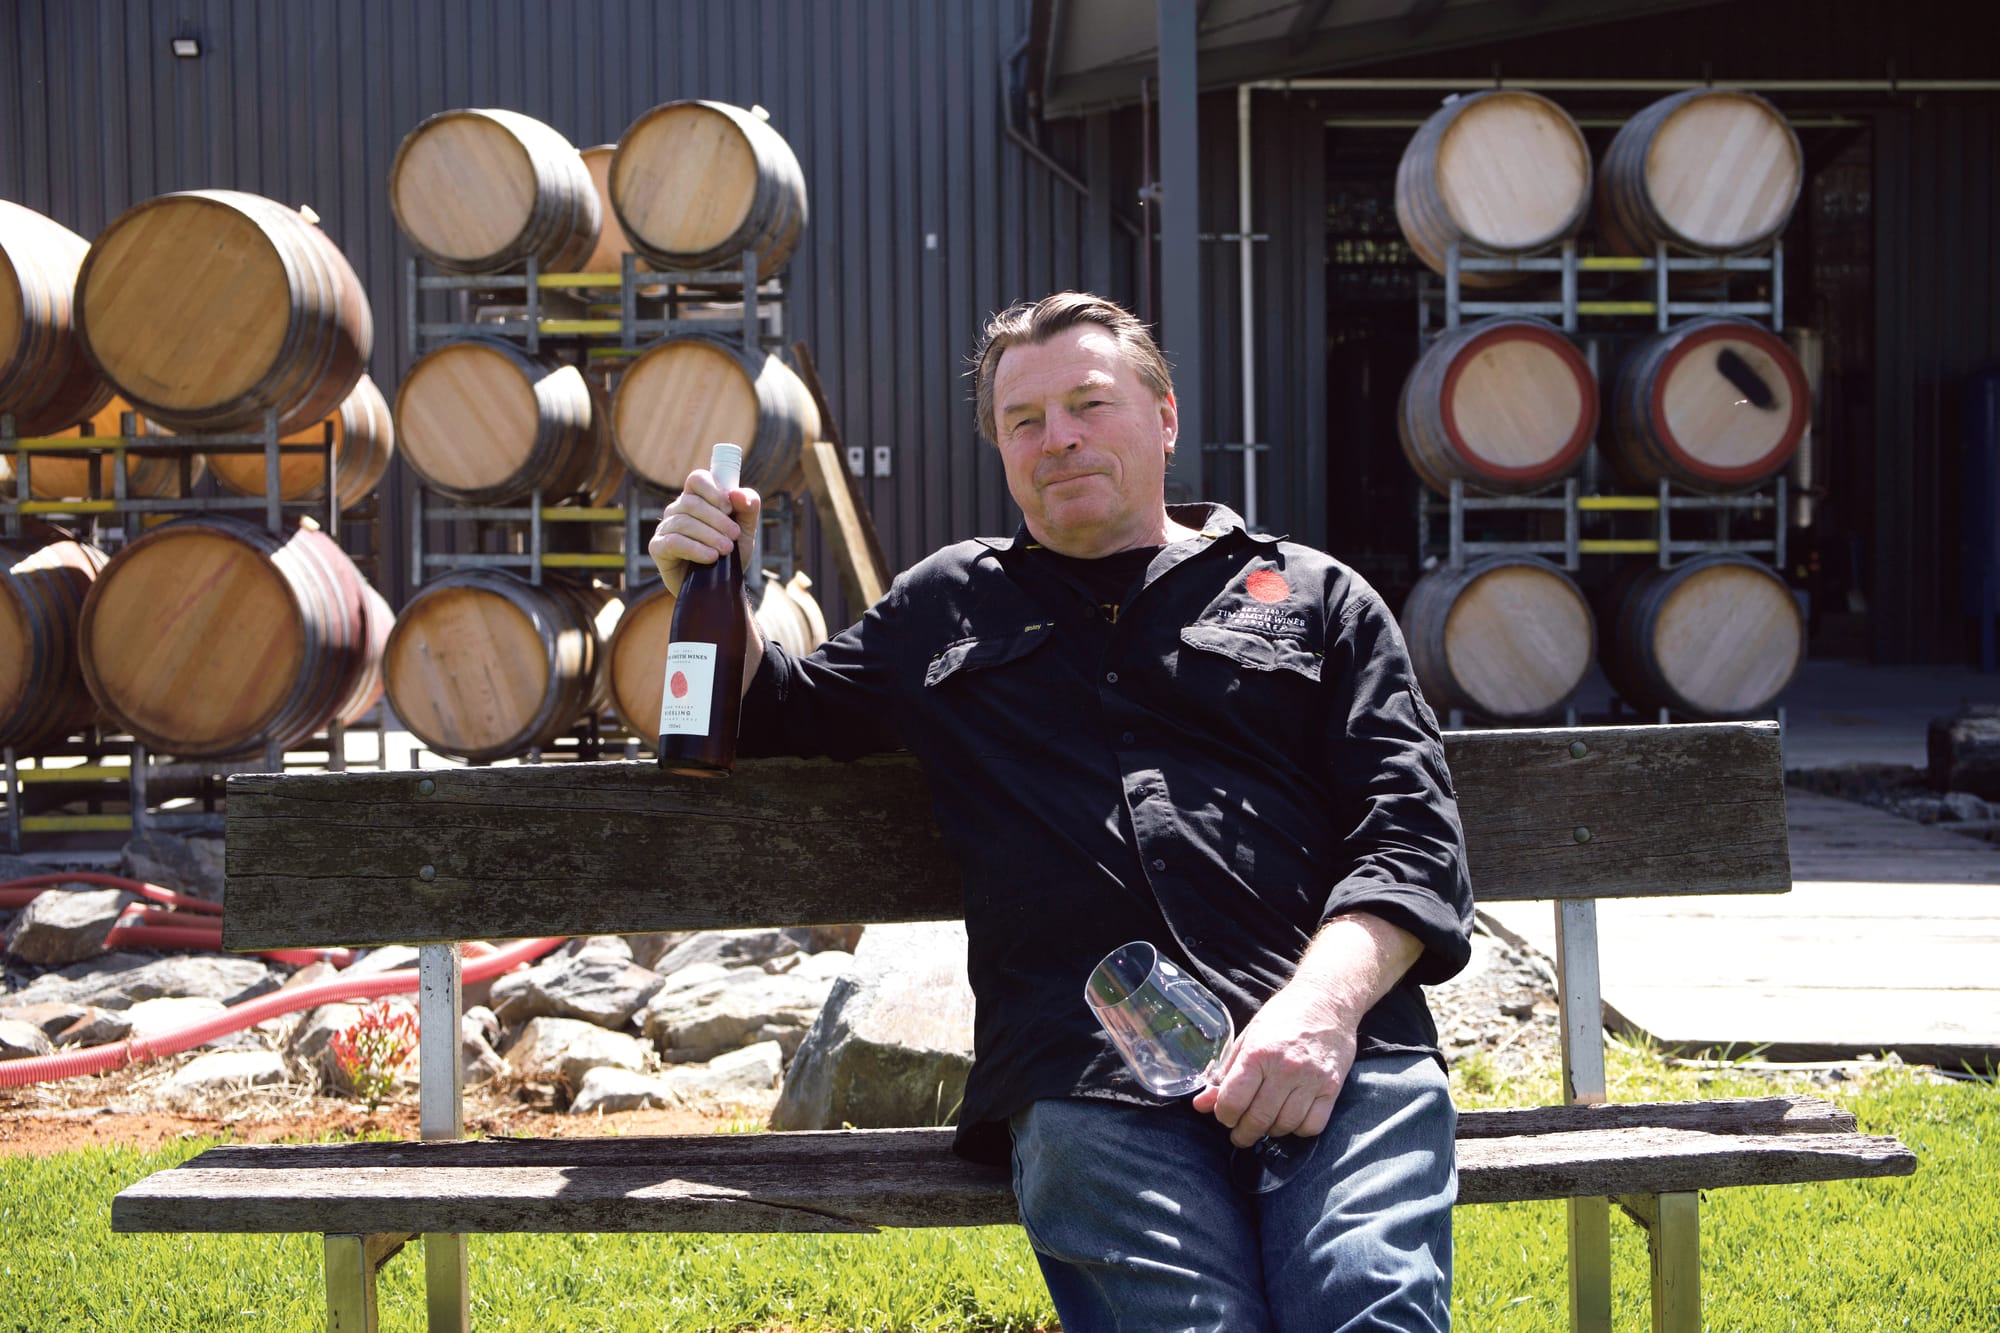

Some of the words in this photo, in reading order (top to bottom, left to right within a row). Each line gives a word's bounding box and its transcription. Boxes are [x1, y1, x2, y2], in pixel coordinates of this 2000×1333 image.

[1217, 609, 1236, 619] TIM
[1239, 612, 1271, 622] SMITH
[1274, 616, 1305, 627] WINES
